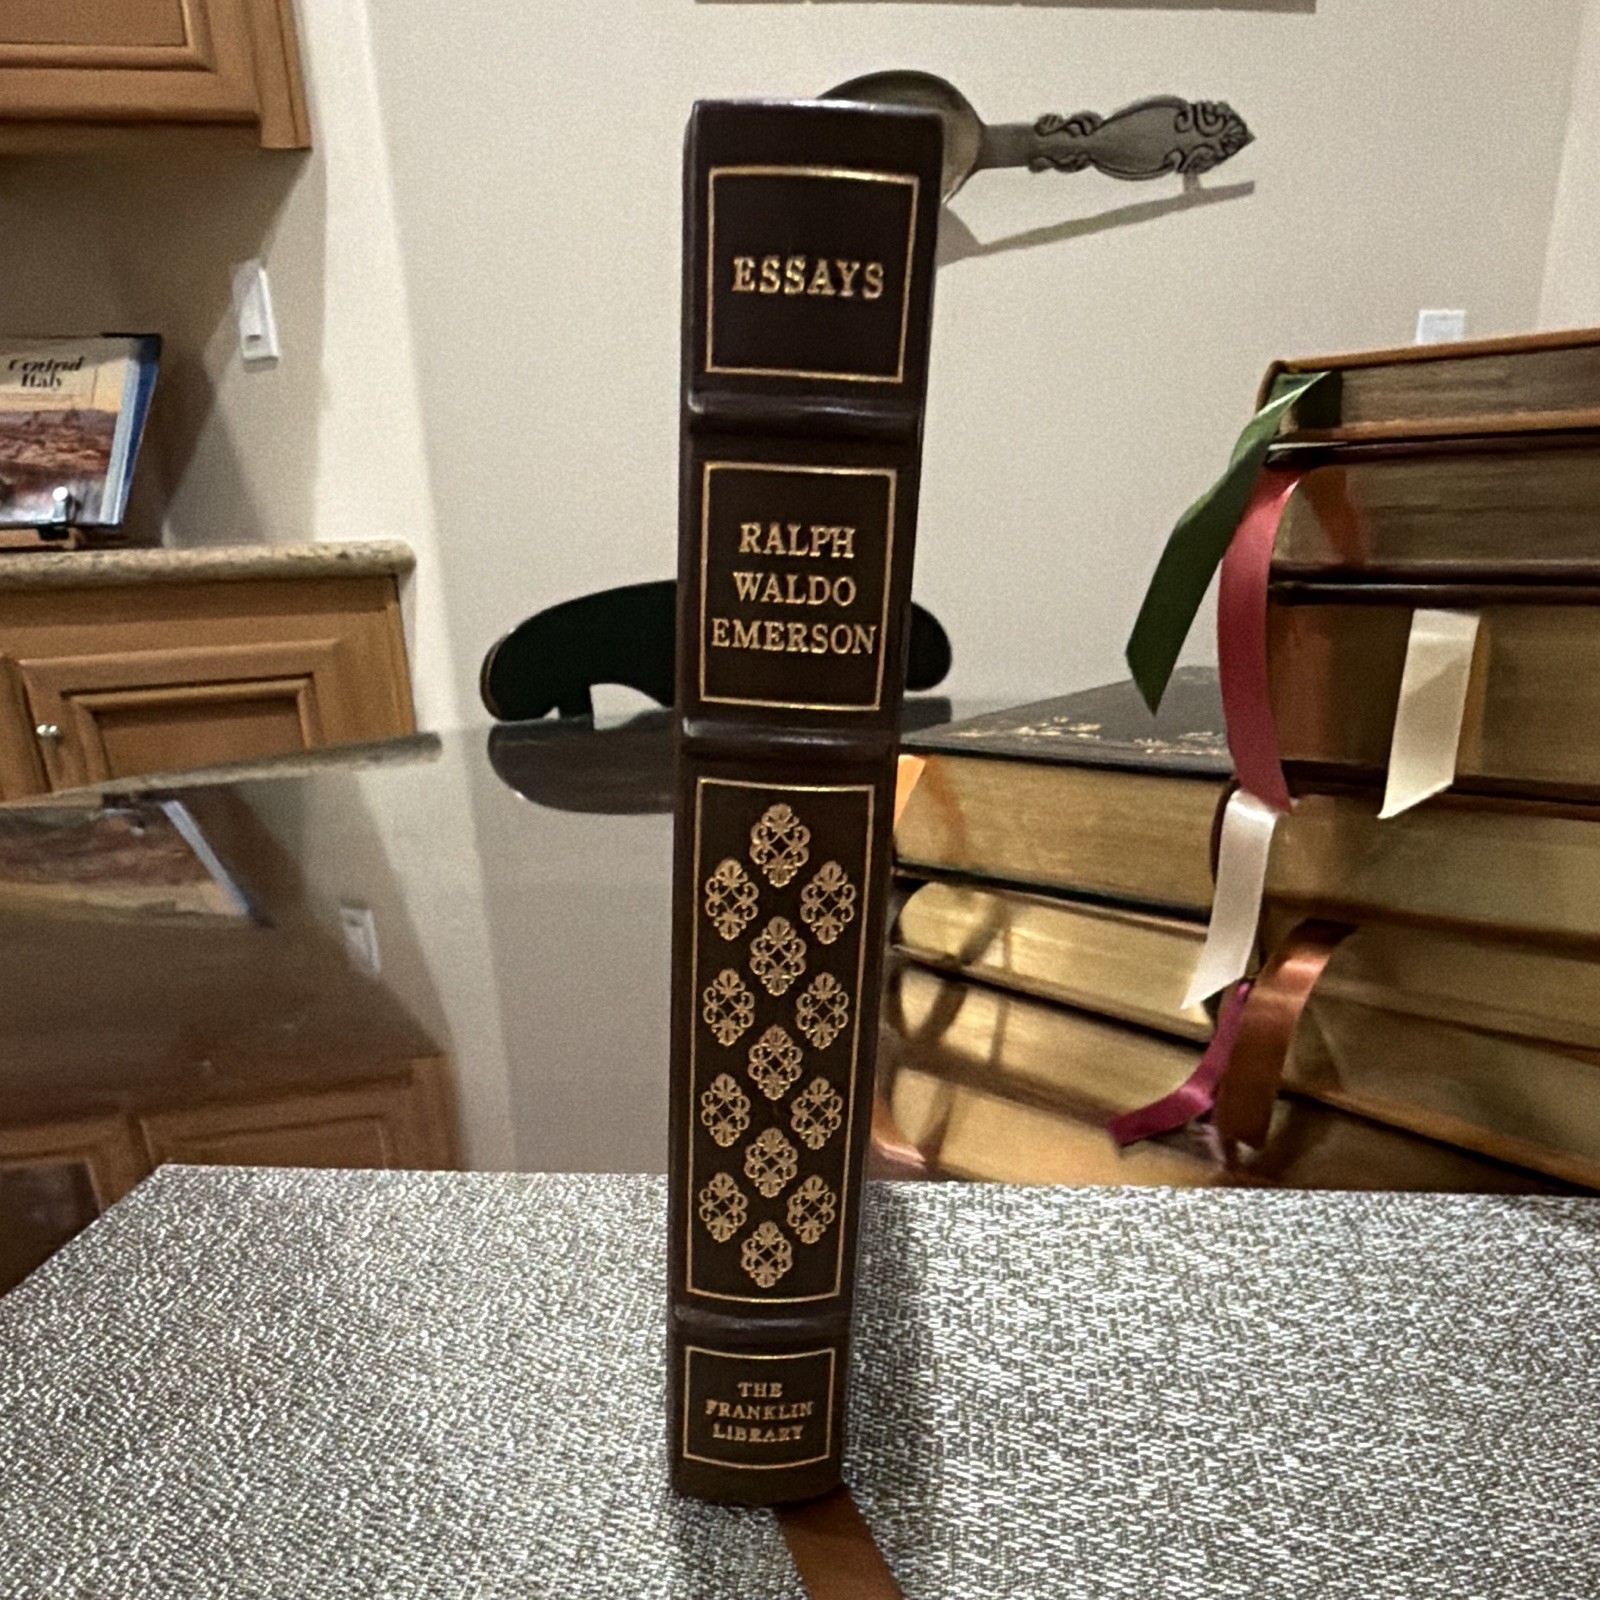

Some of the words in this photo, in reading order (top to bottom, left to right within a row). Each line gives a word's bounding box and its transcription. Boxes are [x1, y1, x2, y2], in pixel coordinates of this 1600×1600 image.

[732, 255, 884, 299] ESSAYS
[738, 522, 855, 558] RALPH
[732, 571, 856, 606] WALDO
[711, 618, 877, 655] EMERSON
[737, 1382, 783, 1398] THE
[705, 1399, 813, 1420] FRANKLIN
[712, 1423, 803, 1443] LIBRARY
